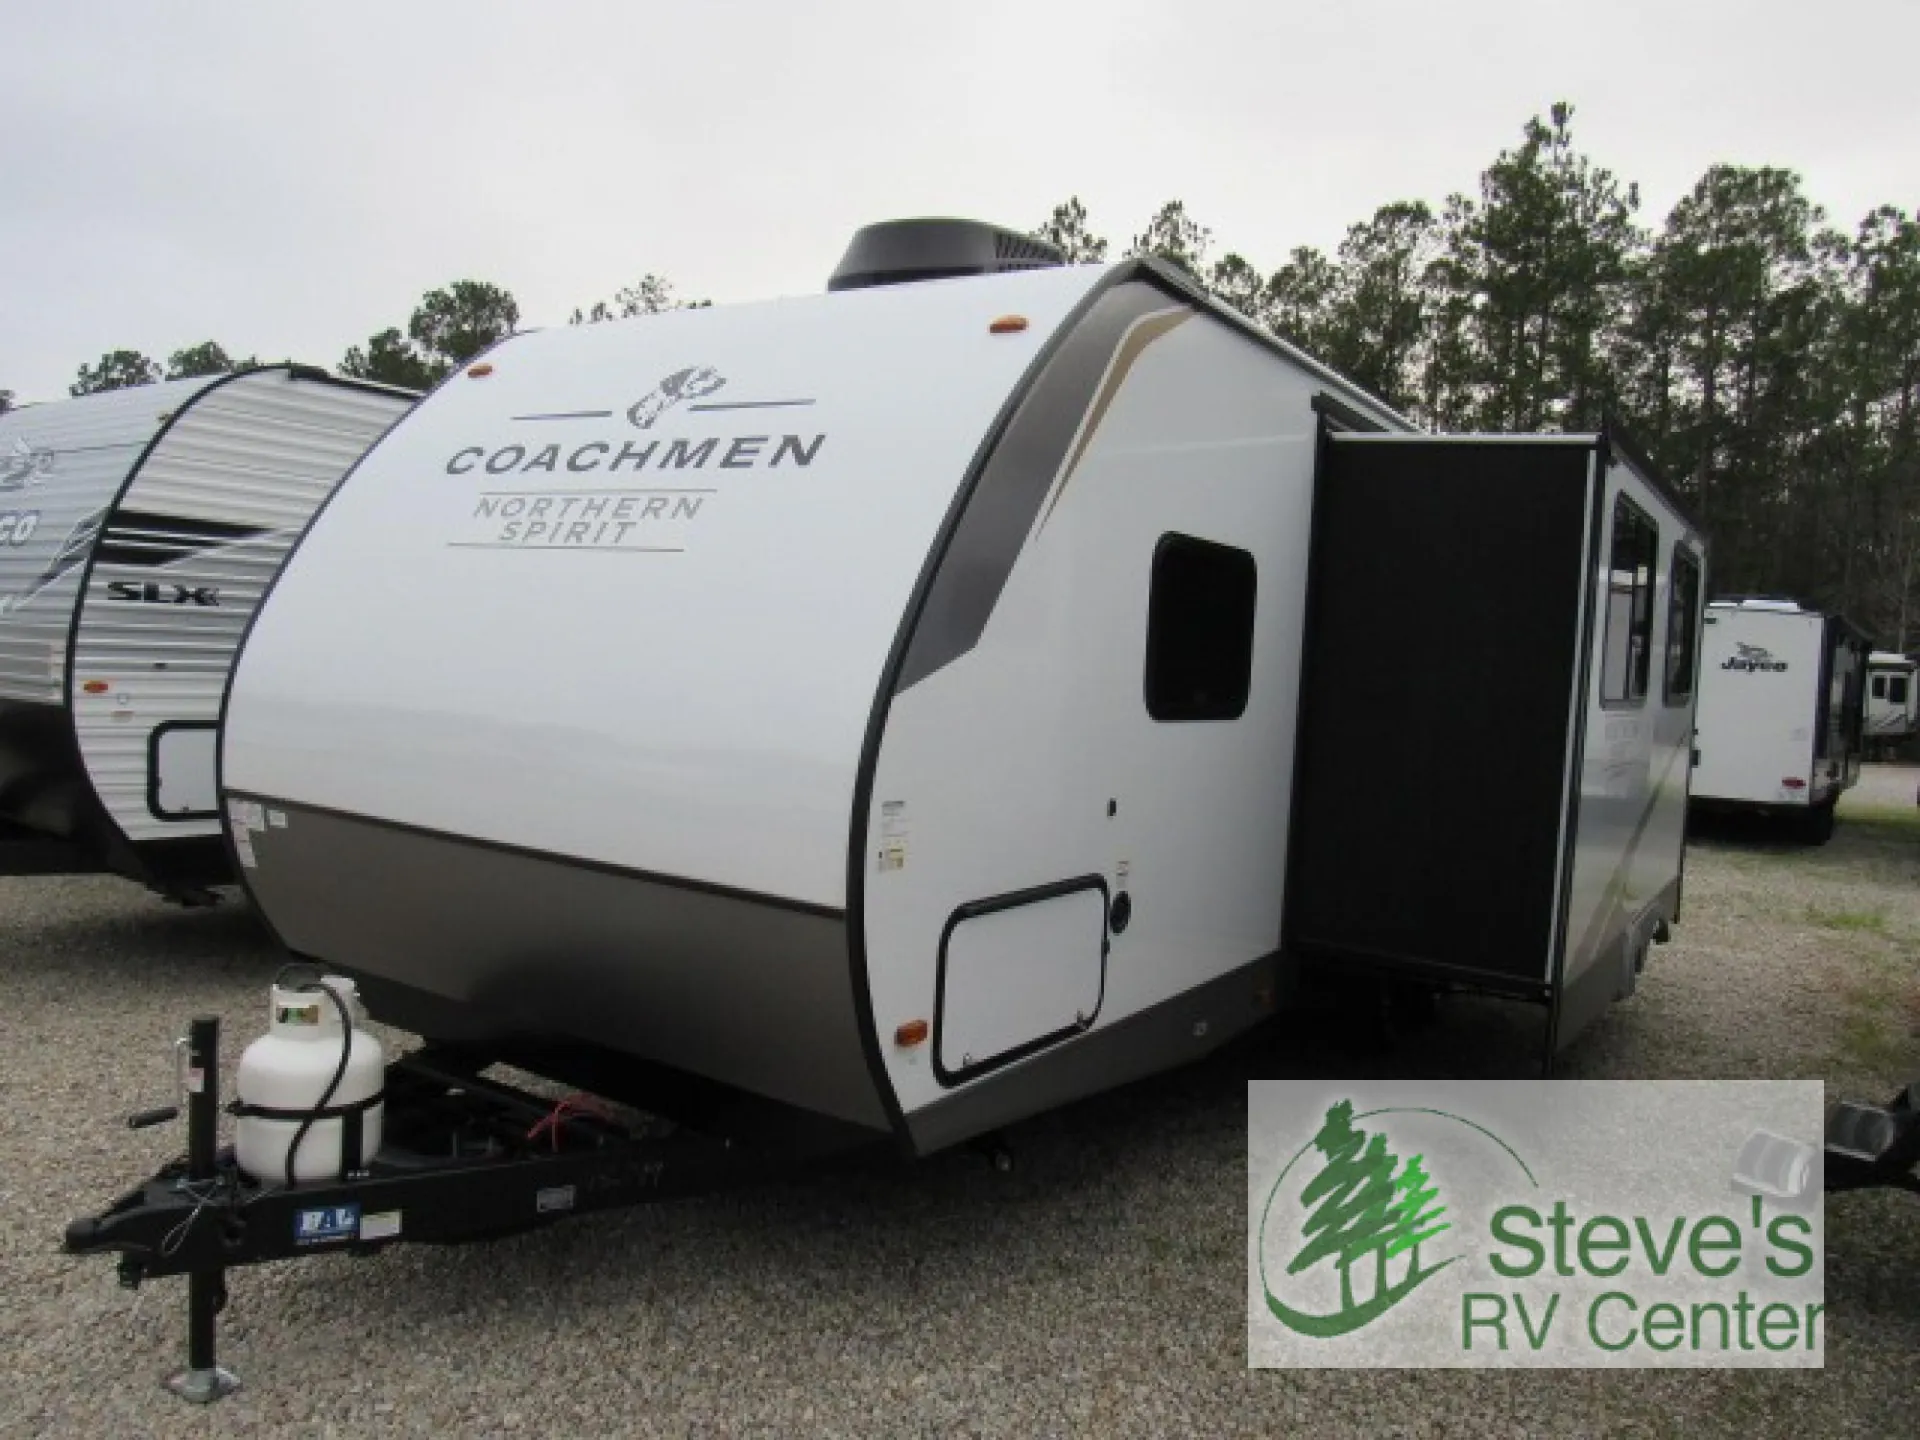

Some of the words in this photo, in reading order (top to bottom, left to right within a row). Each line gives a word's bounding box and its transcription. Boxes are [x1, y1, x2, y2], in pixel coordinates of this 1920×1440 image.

[446, 433, 826, 475] COACHMEN
[472, 496, 704, 520] NORTHERN
[498, 521, 638, 545] SPIRIT
